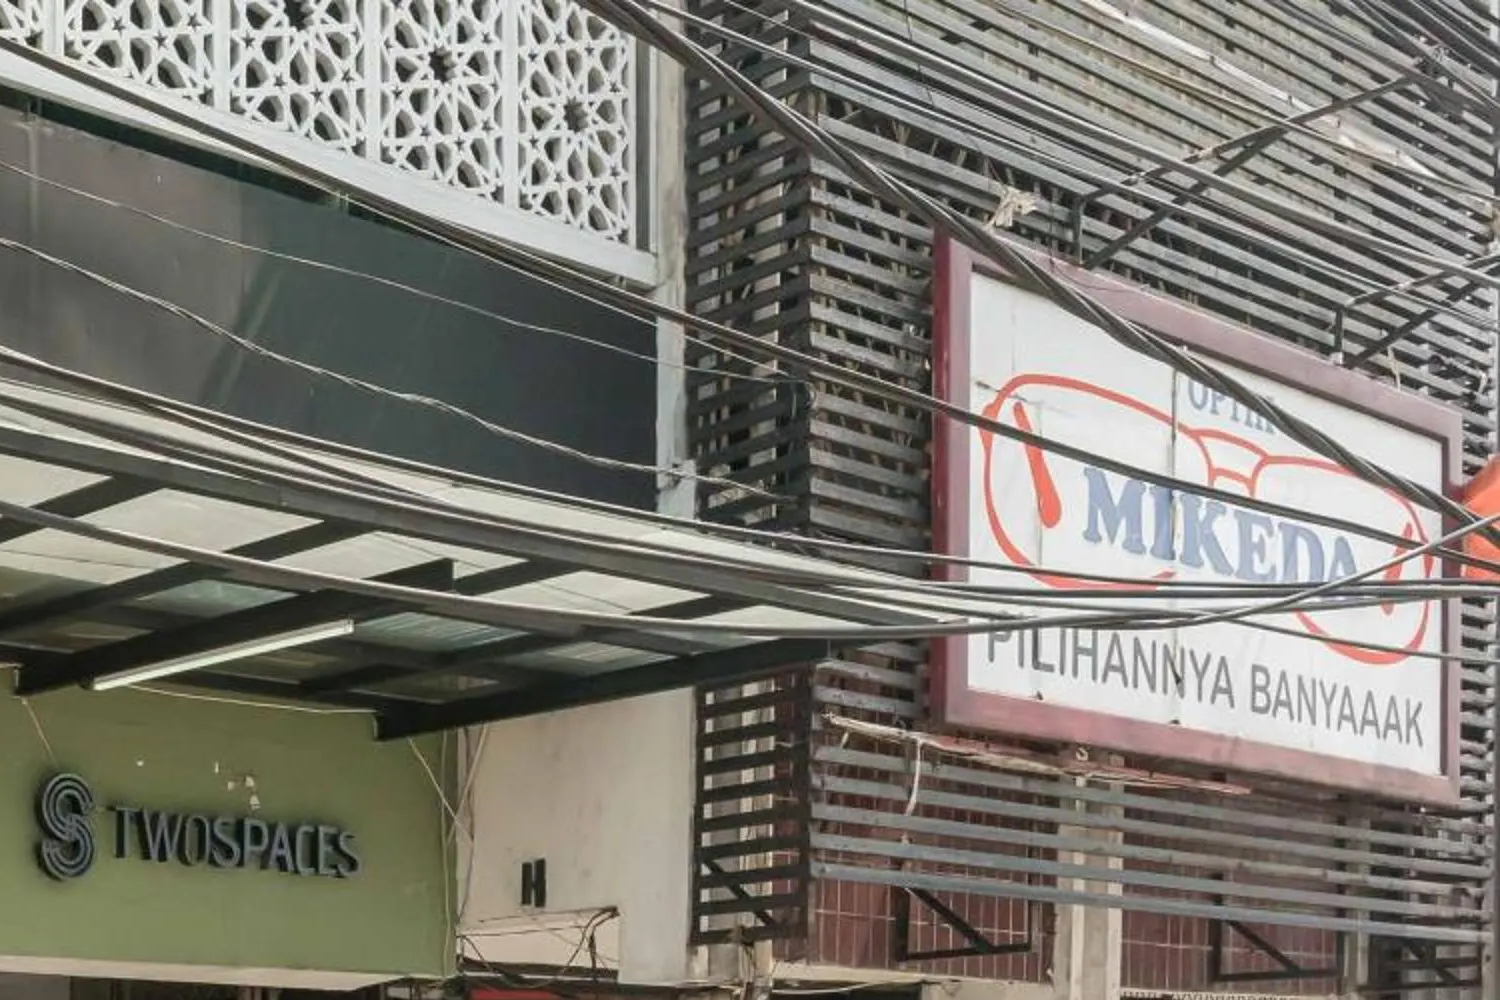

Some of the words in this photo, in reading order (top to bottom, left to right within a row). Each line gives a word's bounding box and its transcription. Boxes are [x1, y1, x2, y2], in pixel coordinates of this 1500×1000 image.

[1082, 466, 1366, 596] MIKEDA
[987, 626, 1235, 709] PILIHANNYA
[1249, 663, 1424, 746] BANYAAAK
[113, 805, 362, 879] TWOSPACES
